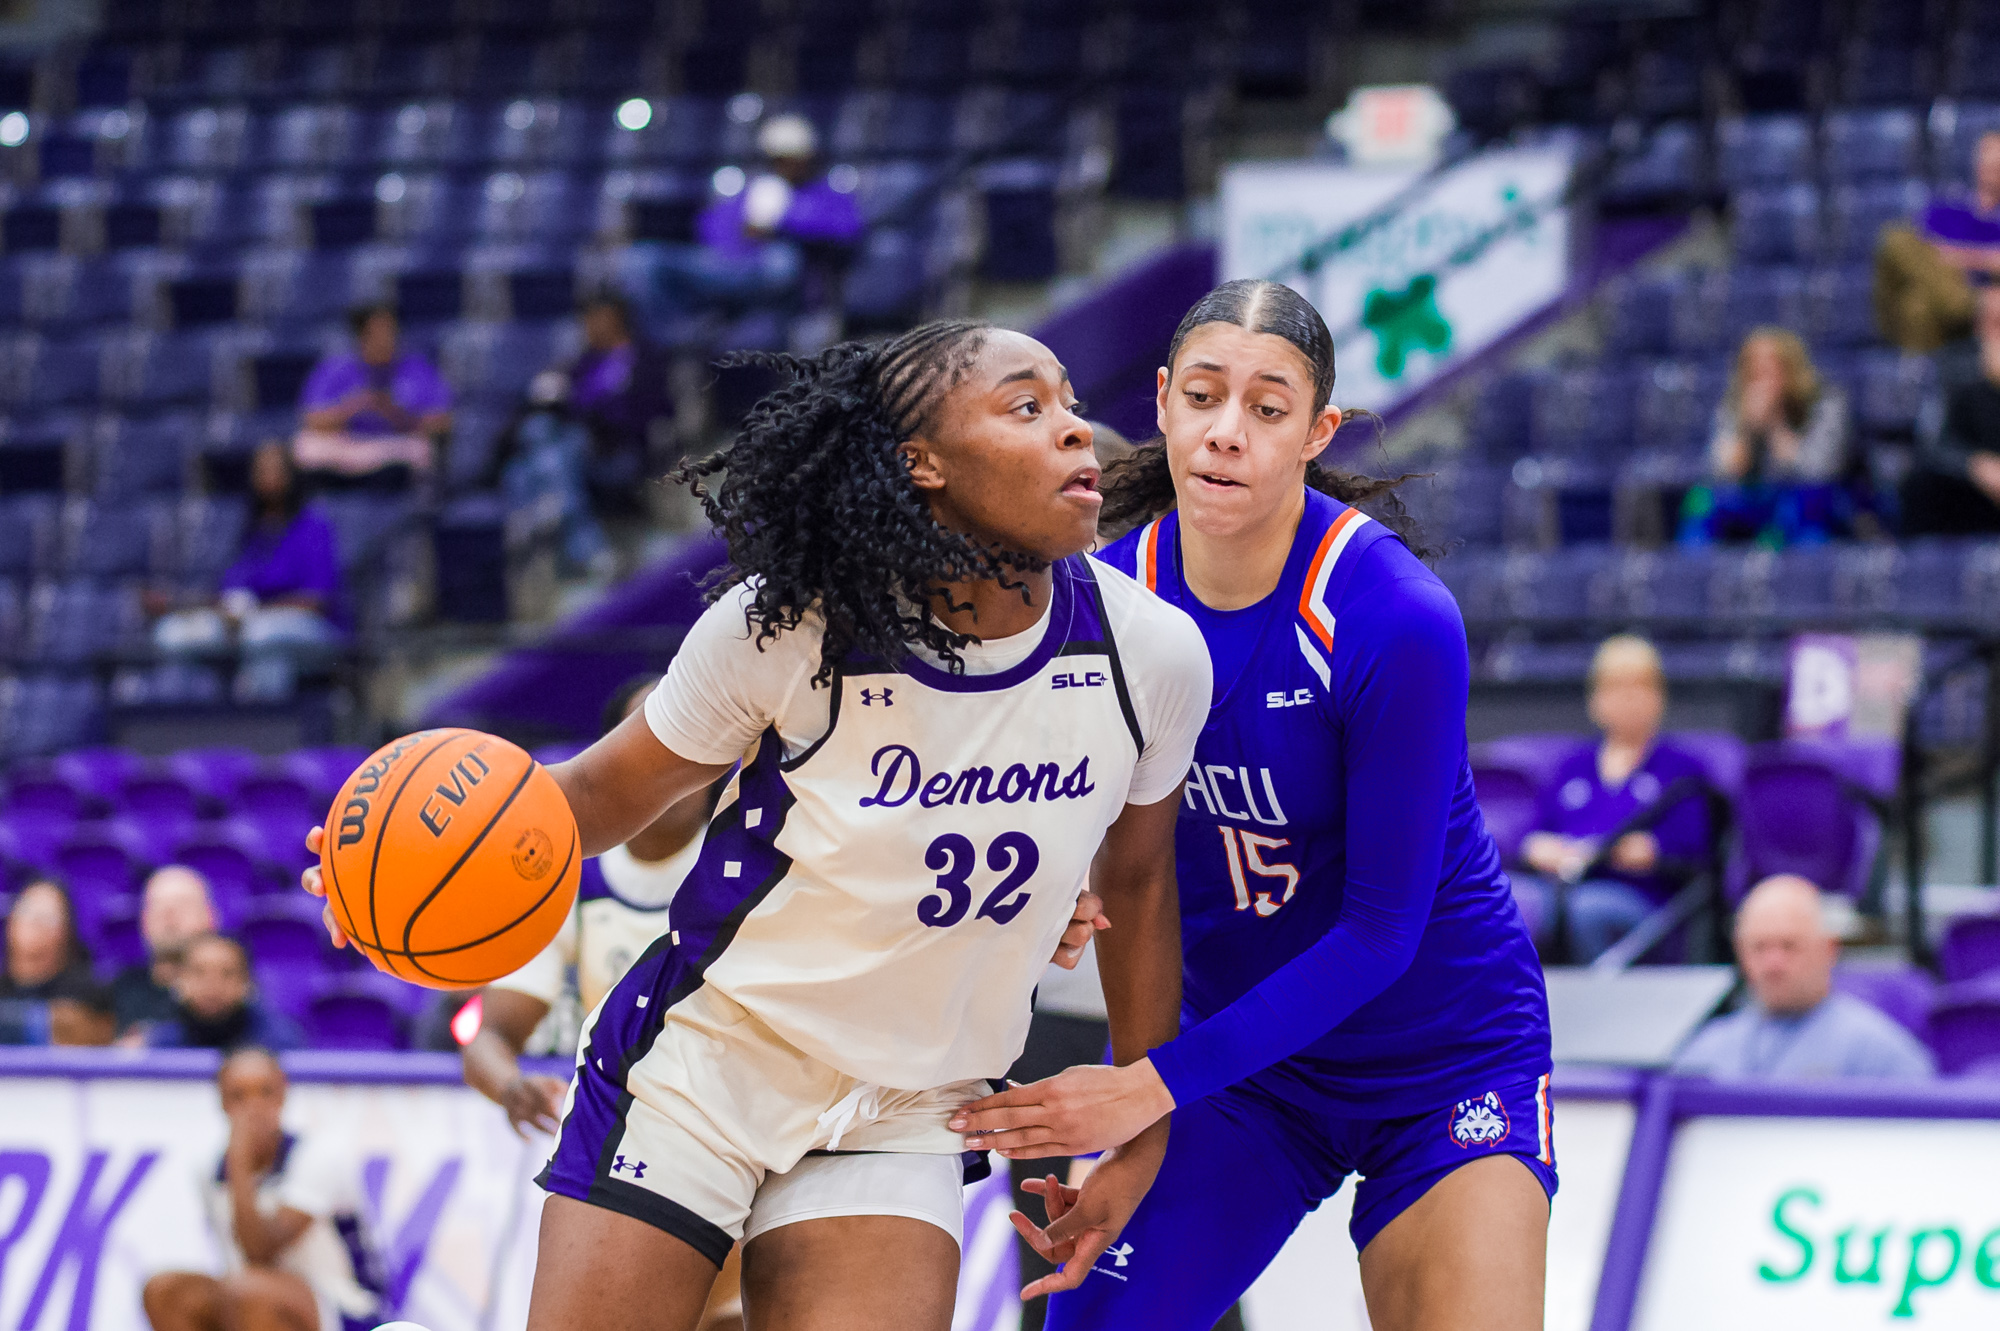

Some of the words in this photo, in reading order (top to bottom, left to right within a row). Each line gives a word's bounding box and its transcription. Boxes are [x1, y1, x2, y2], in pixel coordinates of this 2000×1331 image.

[1051, 671, 1108, 690] SLC
[1266, 688, 1312, 708] SLC
[419, 752, 490, 838] EVO
[859, 744, 1095, 808] Demons
[1184, 761, 1288, 825] ACU
[917, 831, 1040, 927] 32
[1218, 825, 1300, 917] 15
